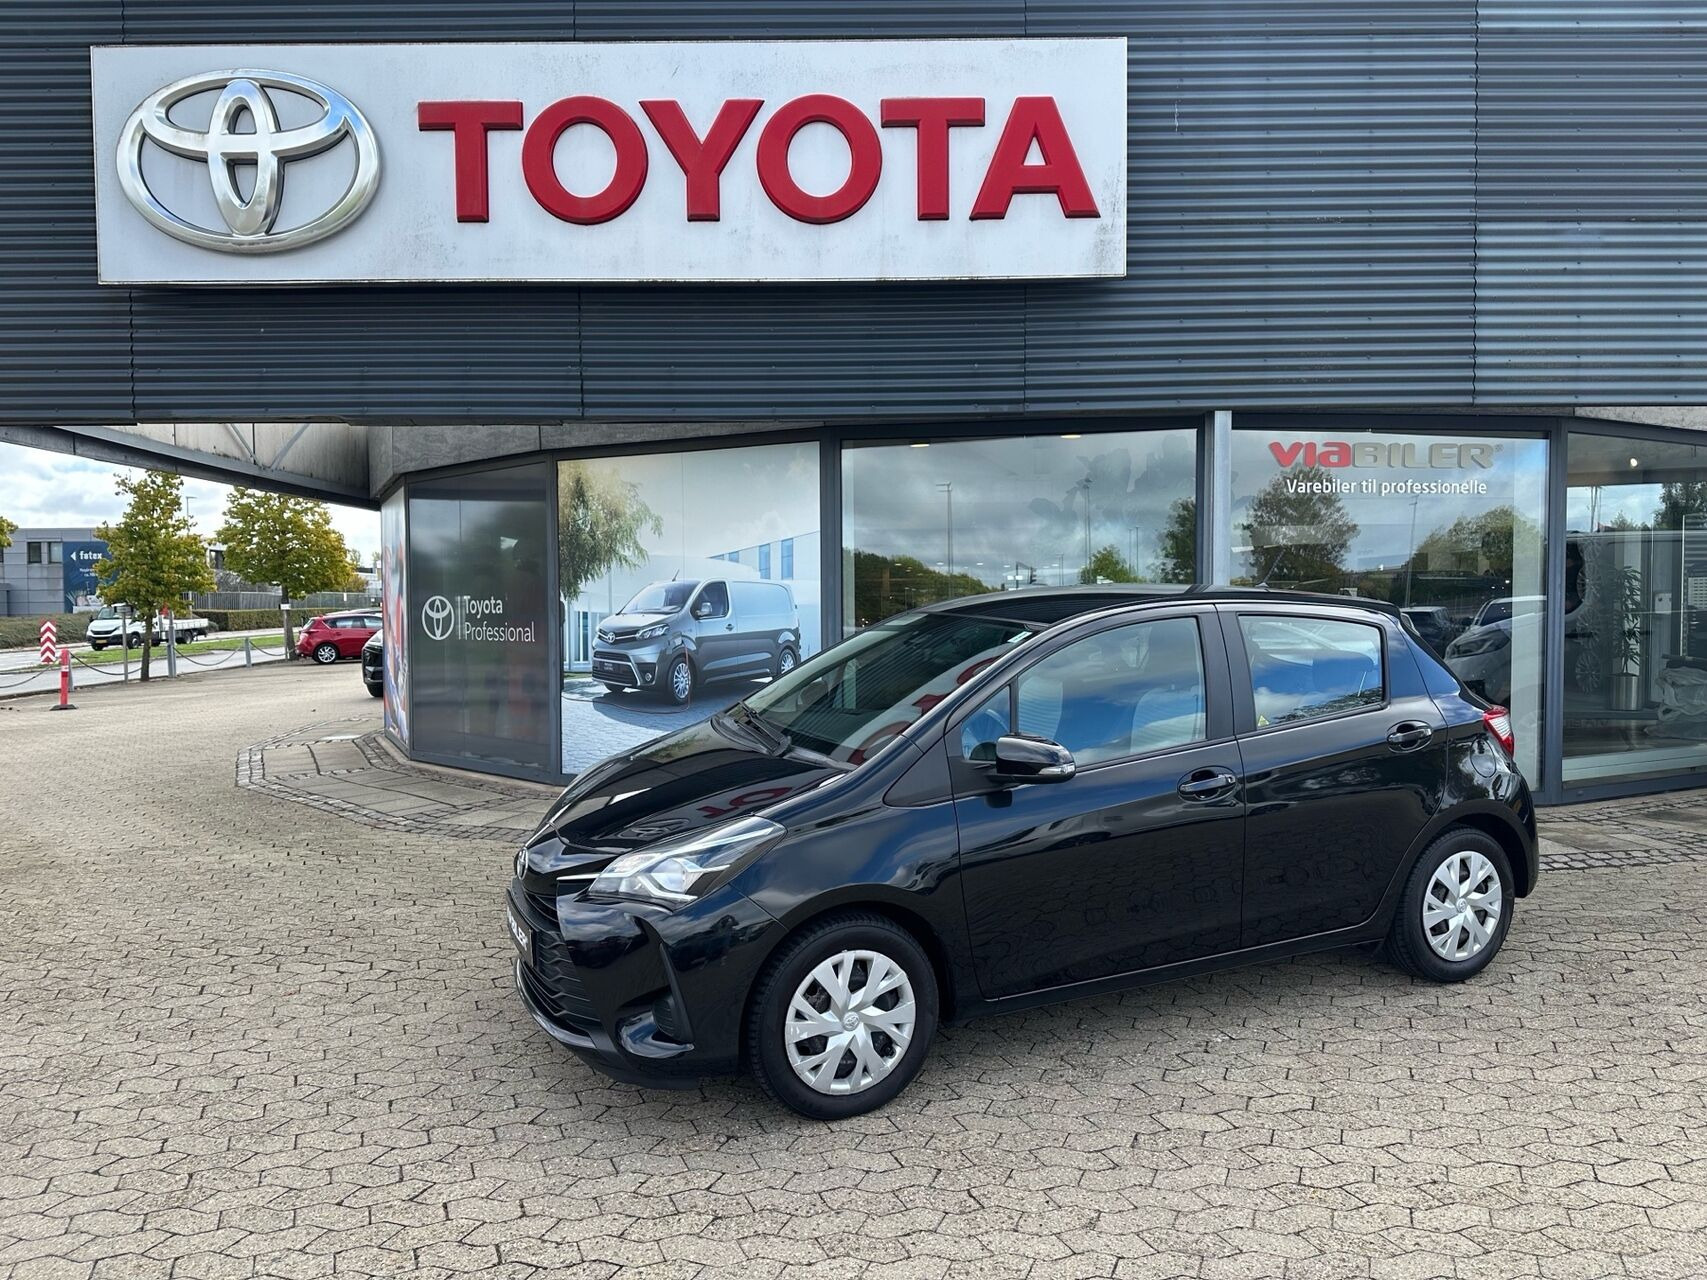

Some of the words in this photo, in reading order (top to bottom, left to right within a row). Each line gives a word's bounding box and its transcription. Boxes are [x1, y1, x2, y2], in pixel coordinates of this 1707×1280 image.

[418, 94, 1100, 225] TOYOTA
[1286, 478, 1356, 493] Varebiler
[1361, 479, 1376, 493] til
[1381, 480, 1487, 496] professionelle
[464, 595, 503, 619] Toyota
[464, 621, 535, 642] Professional
